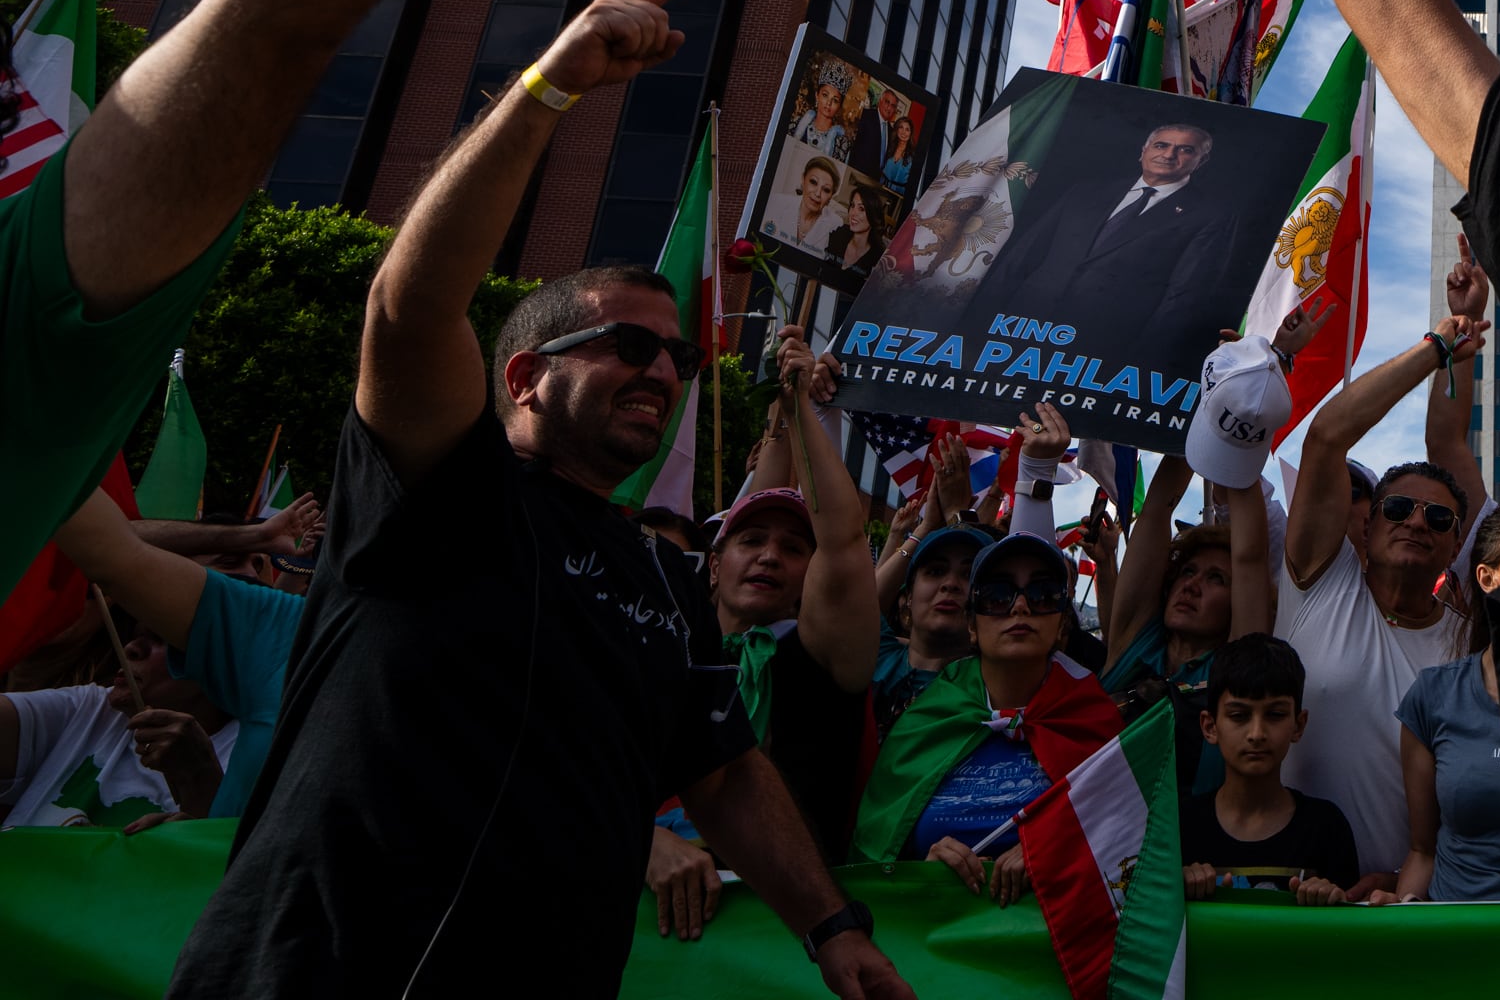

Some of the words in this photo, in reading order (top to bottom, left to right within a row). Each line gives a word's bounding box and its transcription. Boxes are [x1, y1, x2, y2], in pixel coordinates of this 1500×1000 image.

[987, 313, 1077, 346] KING
[841, 320, 964, 370] REZA
[973, 340, 1201, 412] PAHLAVI
[840, 362, 1027, 400] ALTERNATIVE
[1041, 390, 1097, 411] FOR
[1113, 402, 1187, 430] IRAN
[1217, 406, 1267, 443] USA
